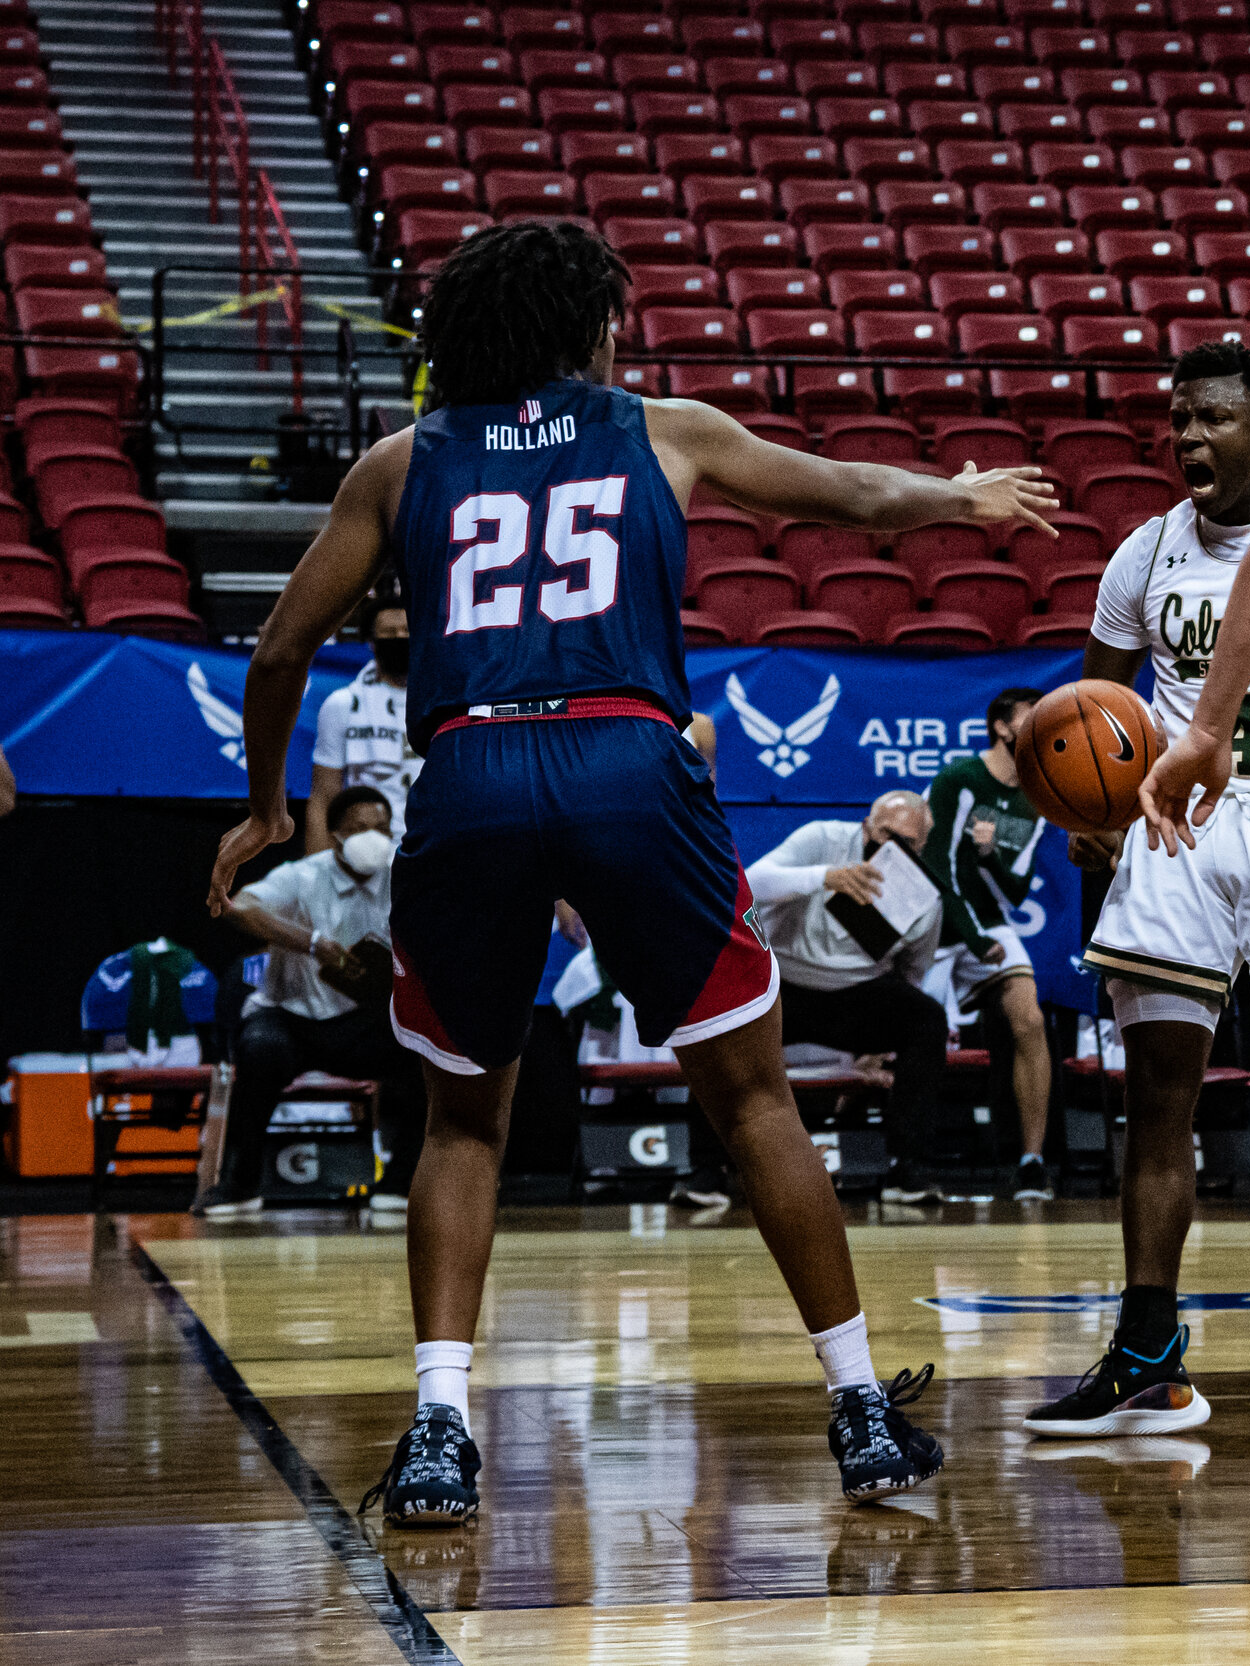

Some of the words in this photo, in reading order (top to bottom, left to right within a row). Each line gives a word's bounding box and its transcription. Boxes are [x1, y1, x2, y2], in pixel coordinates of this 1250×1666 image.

[485, 414, 576, 451] HOLLAND
[444, 474, 629, 636] 25
[858, 718, 947, 747] AIR
[276, 1142, 320, 1184] G
[629, 1126, 668, 1166] G
